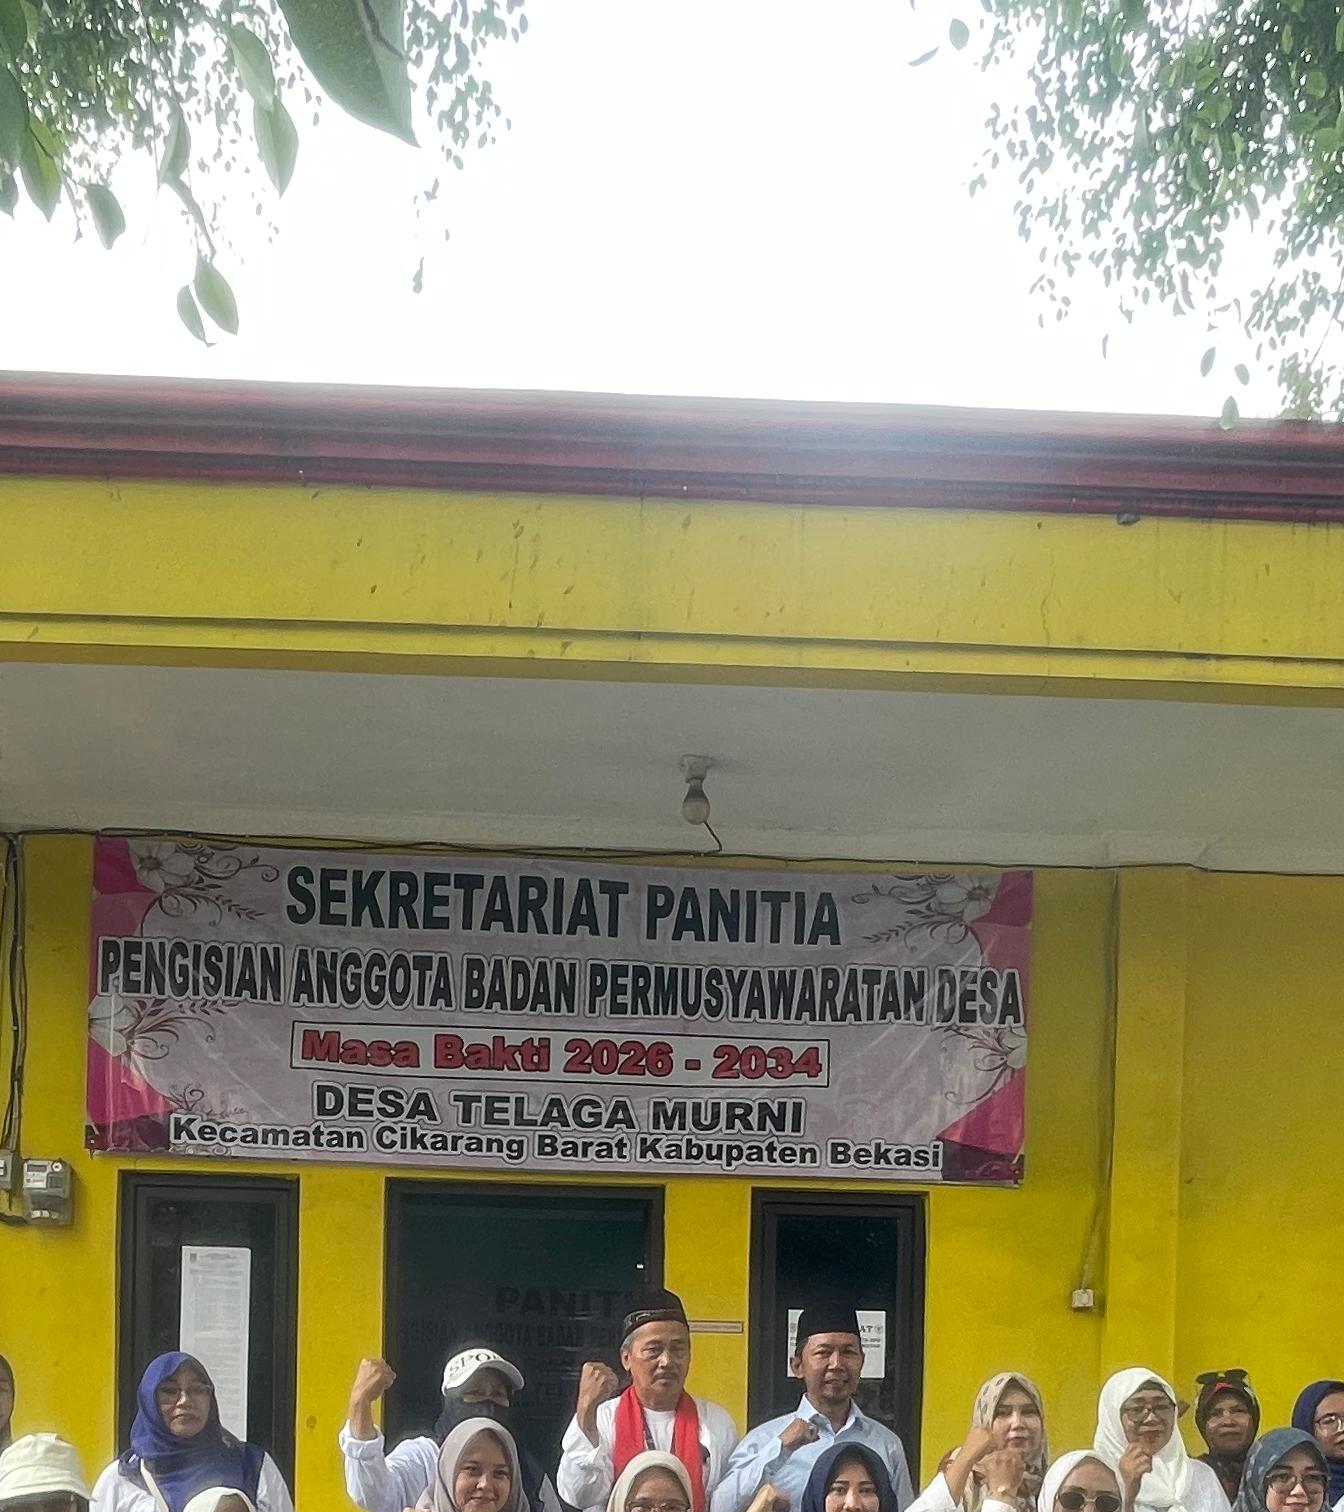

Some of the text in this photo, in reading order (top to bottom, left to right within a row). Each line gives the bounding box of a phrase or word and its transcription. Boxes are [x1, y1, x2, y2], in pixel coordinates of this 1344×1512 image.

[287, 866, 841, 945] SEKRETARIAT PANITIA
[100, 939, 1023, 1024] PENGISIAN ANGGOTA BADAN PERMUSYAWARATAN DESA
[302, 1029, 420, 1068] Masa
[434, 1033, 551, 1073] Bakti
[563, 1038, 674, 1077] 2026
[712, 1044, 823, 1079] 2034
[316, 1085, 805, 1133] DESA TELAGA MURNI
[173, 1117, 941, 1168] Kecamatan Cikarang Barat Kabupaten Bekasi
